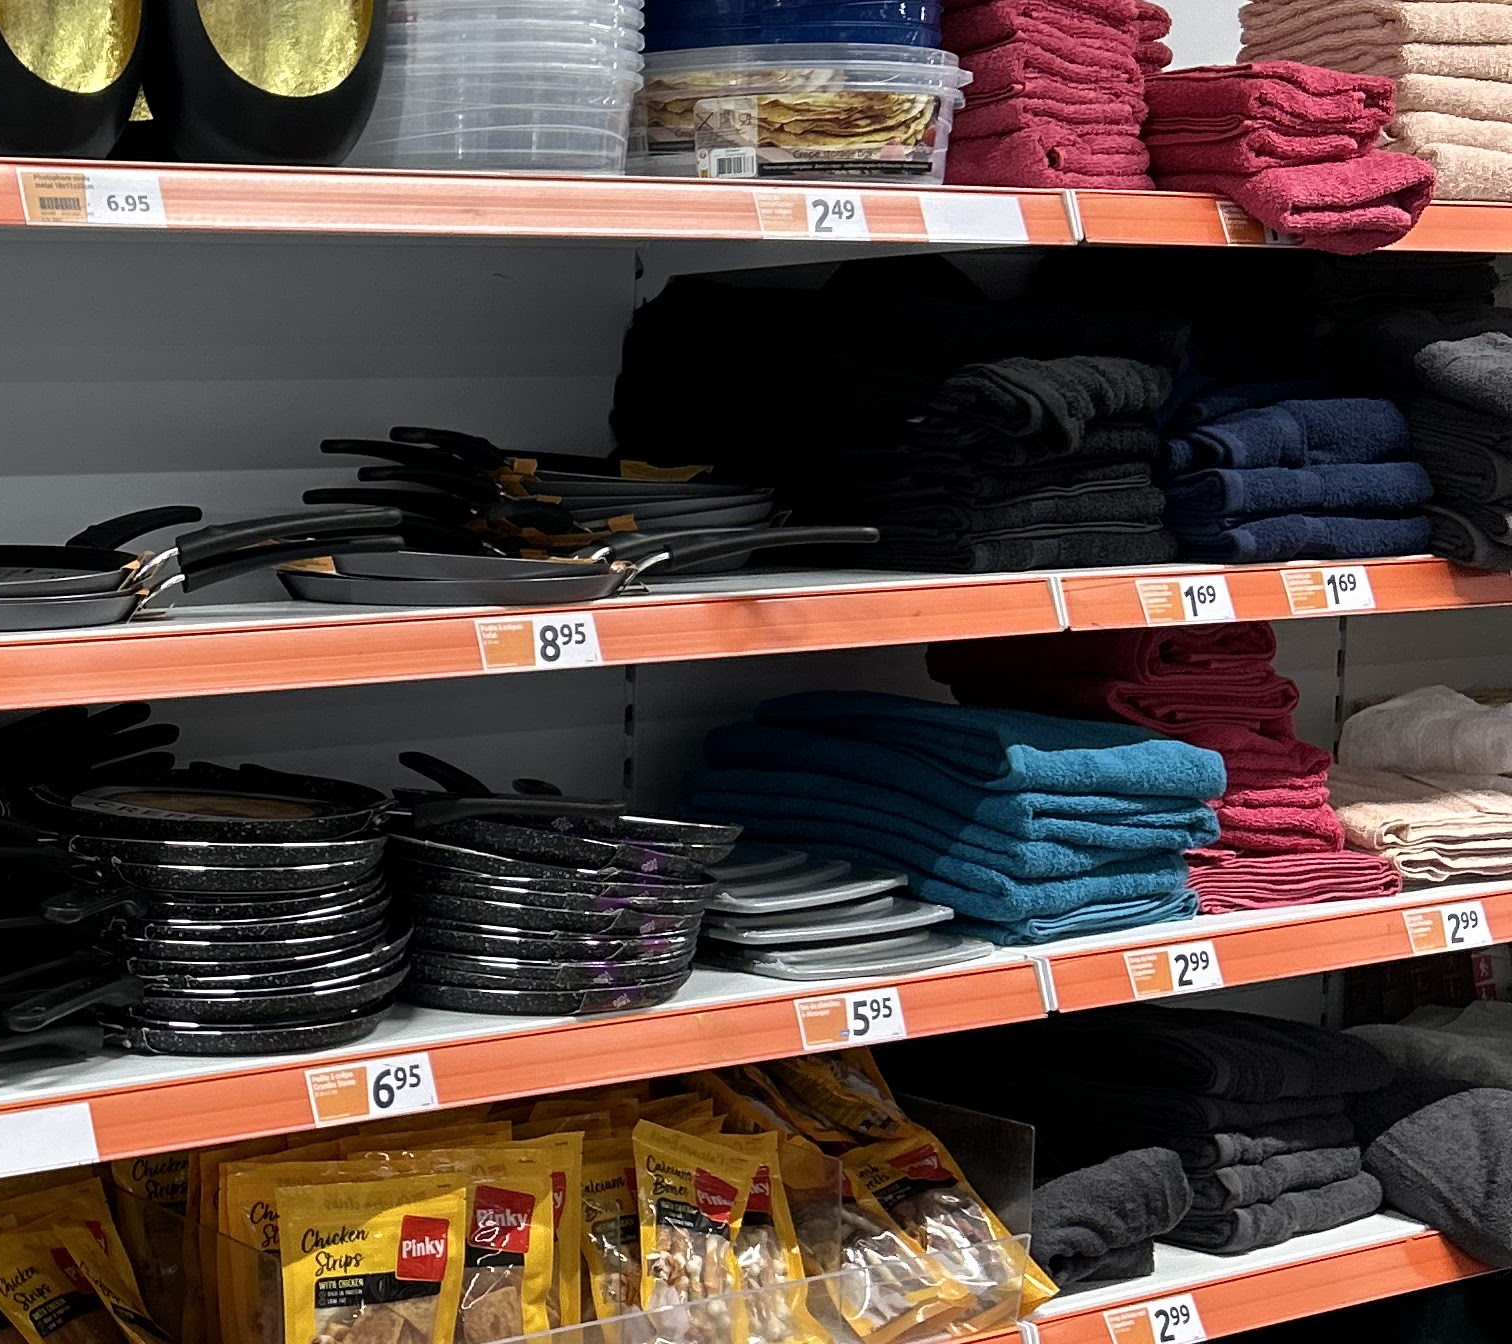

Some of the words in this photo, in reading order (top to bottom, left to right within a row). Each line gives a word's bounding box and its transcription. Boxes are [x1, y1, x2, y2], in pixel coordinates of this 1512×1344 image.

[106, 194, 151, 213] 6.95
[583, 1175, 627, 1194] alcium
[476, 1208, 529, 1232] Pinky
[301, 1227, 369, 1254] Chicken
[402, 1236, 445, 1259] Pinky
[314, 1252, 364, 1277] Strips
